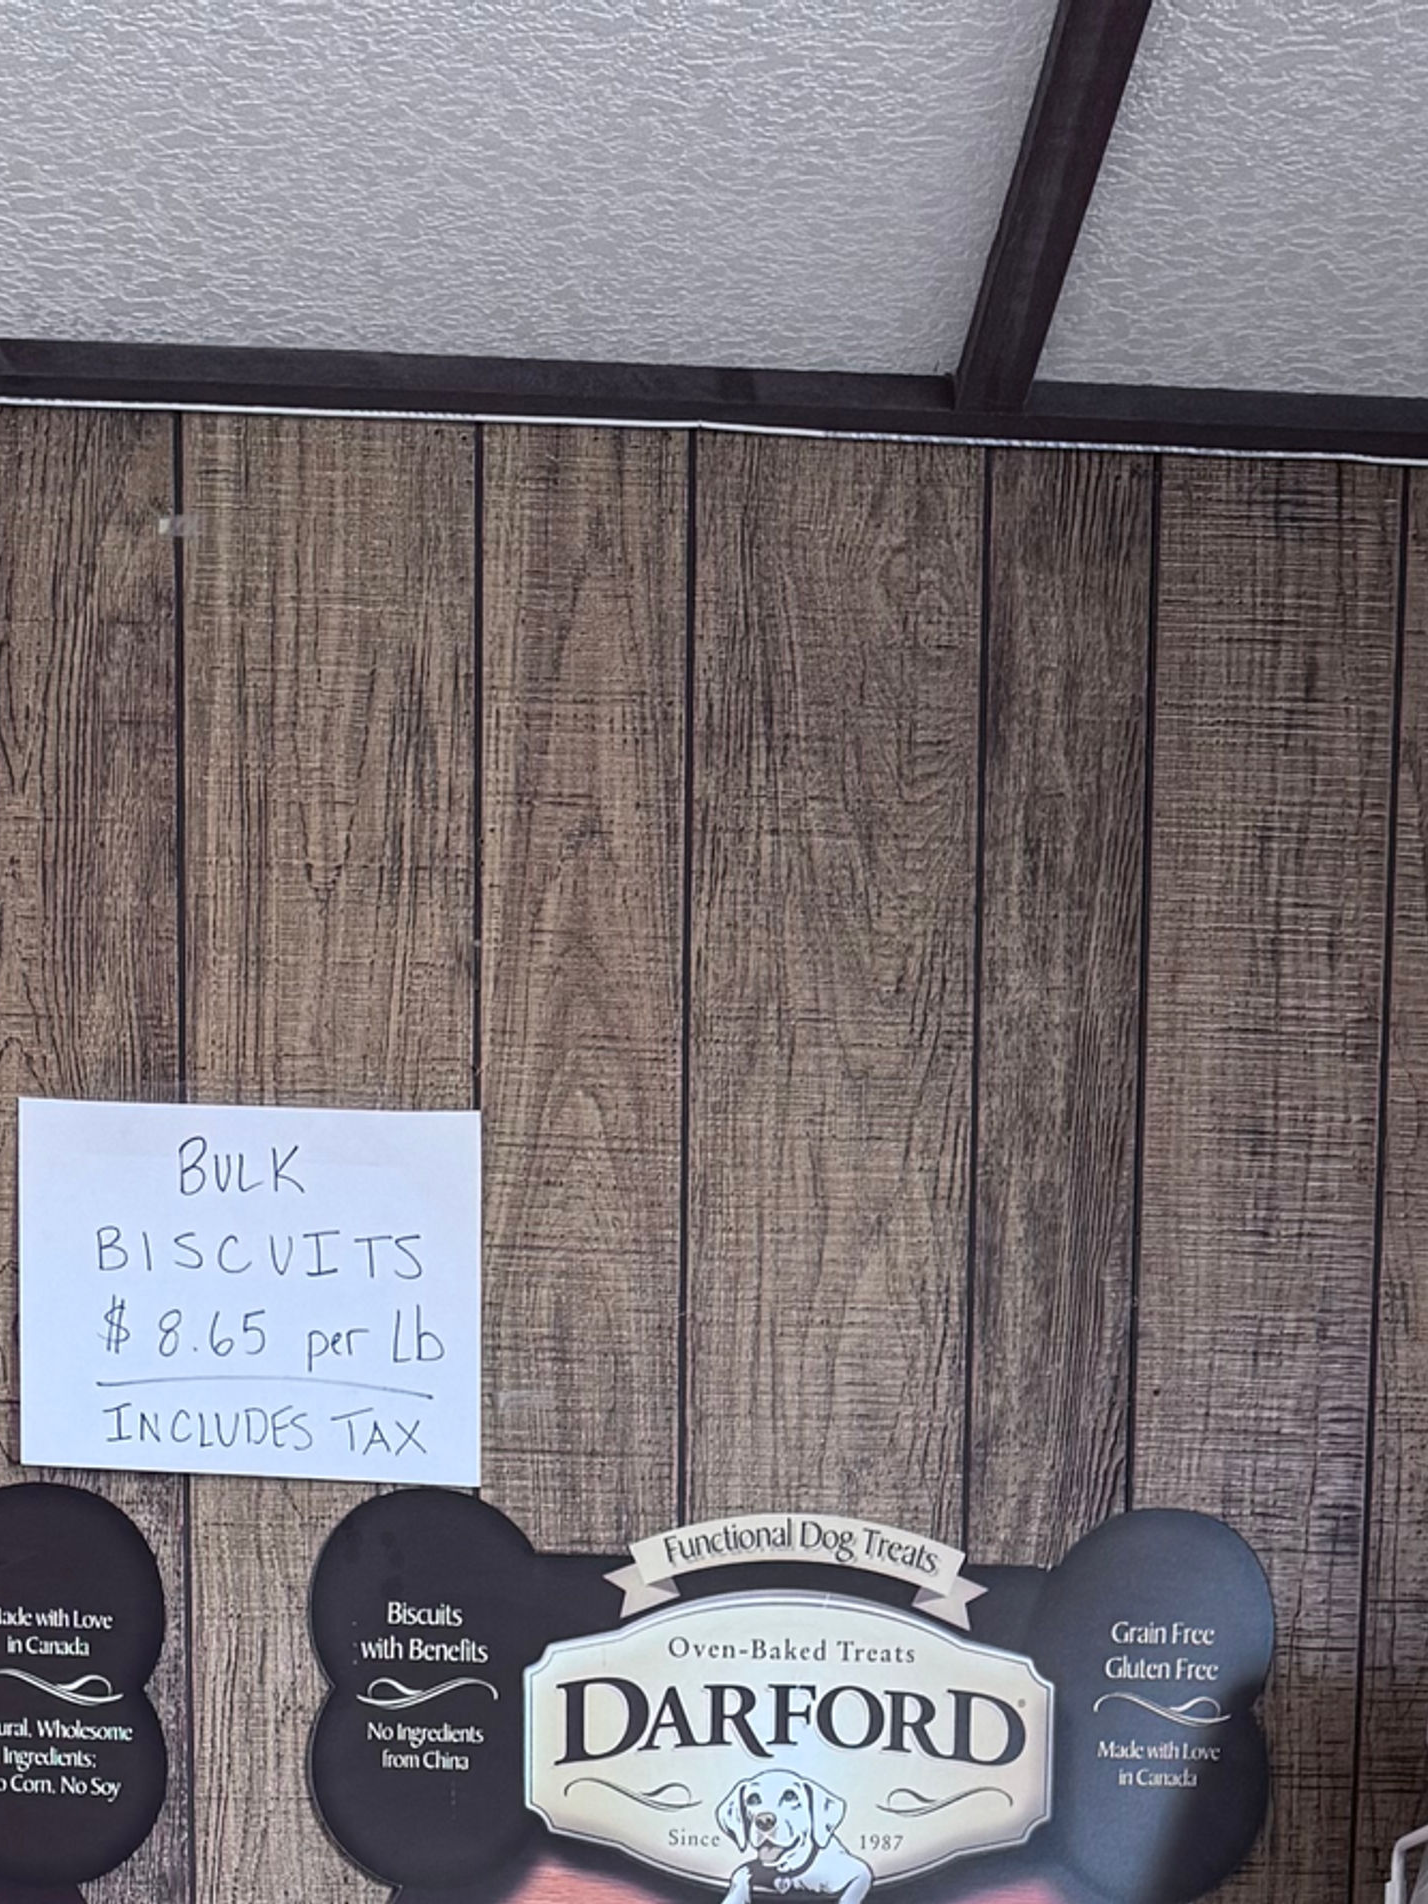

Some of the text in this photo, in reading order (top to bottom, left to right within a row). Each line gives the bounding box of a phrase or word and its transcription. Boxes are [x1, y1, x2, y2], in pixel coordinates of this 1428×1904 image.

[178, 1137, 304, 1195] BULK
[97, 1227, 423, 1279] BISCUITS
[308, 1328, 369, 1372] per
[103, 1404, 427, 1455] INCLUDES TAX
[663, 1518, 938, 1574] Functional Dog Treats
[35, 1609, 70, 1627] with
[73, 1610, 113, 1629] Love
[387, 1601, 463, 1626] Biscuits
[1111, 1621, 1215, 1645] Grain Free
[7, 1636, 89, 1656] in Canada
[361, 1635, 488, 1663] with Benefits
[668, 1636, 914, 1663] Oven-Baked Treats
[1105, 1655, 1219, 1680] Gluten Free
[37, 1719, 133, 1741] Wholesome
[554, 1677, 1026, 1766] DARFORD
[367, 1722, 484, 1748] No Ingredients
[382, 1749, 469, 1770] from China
[1097, 1740, 1220, 1760] Made with Love
[61, 1776, 87, 1795] No
[91, 1778, 121, 1802] Soy
[1119, 1769, 1197, 1787] in Canada
[668, 1829, 903, 1850] Since 1987
